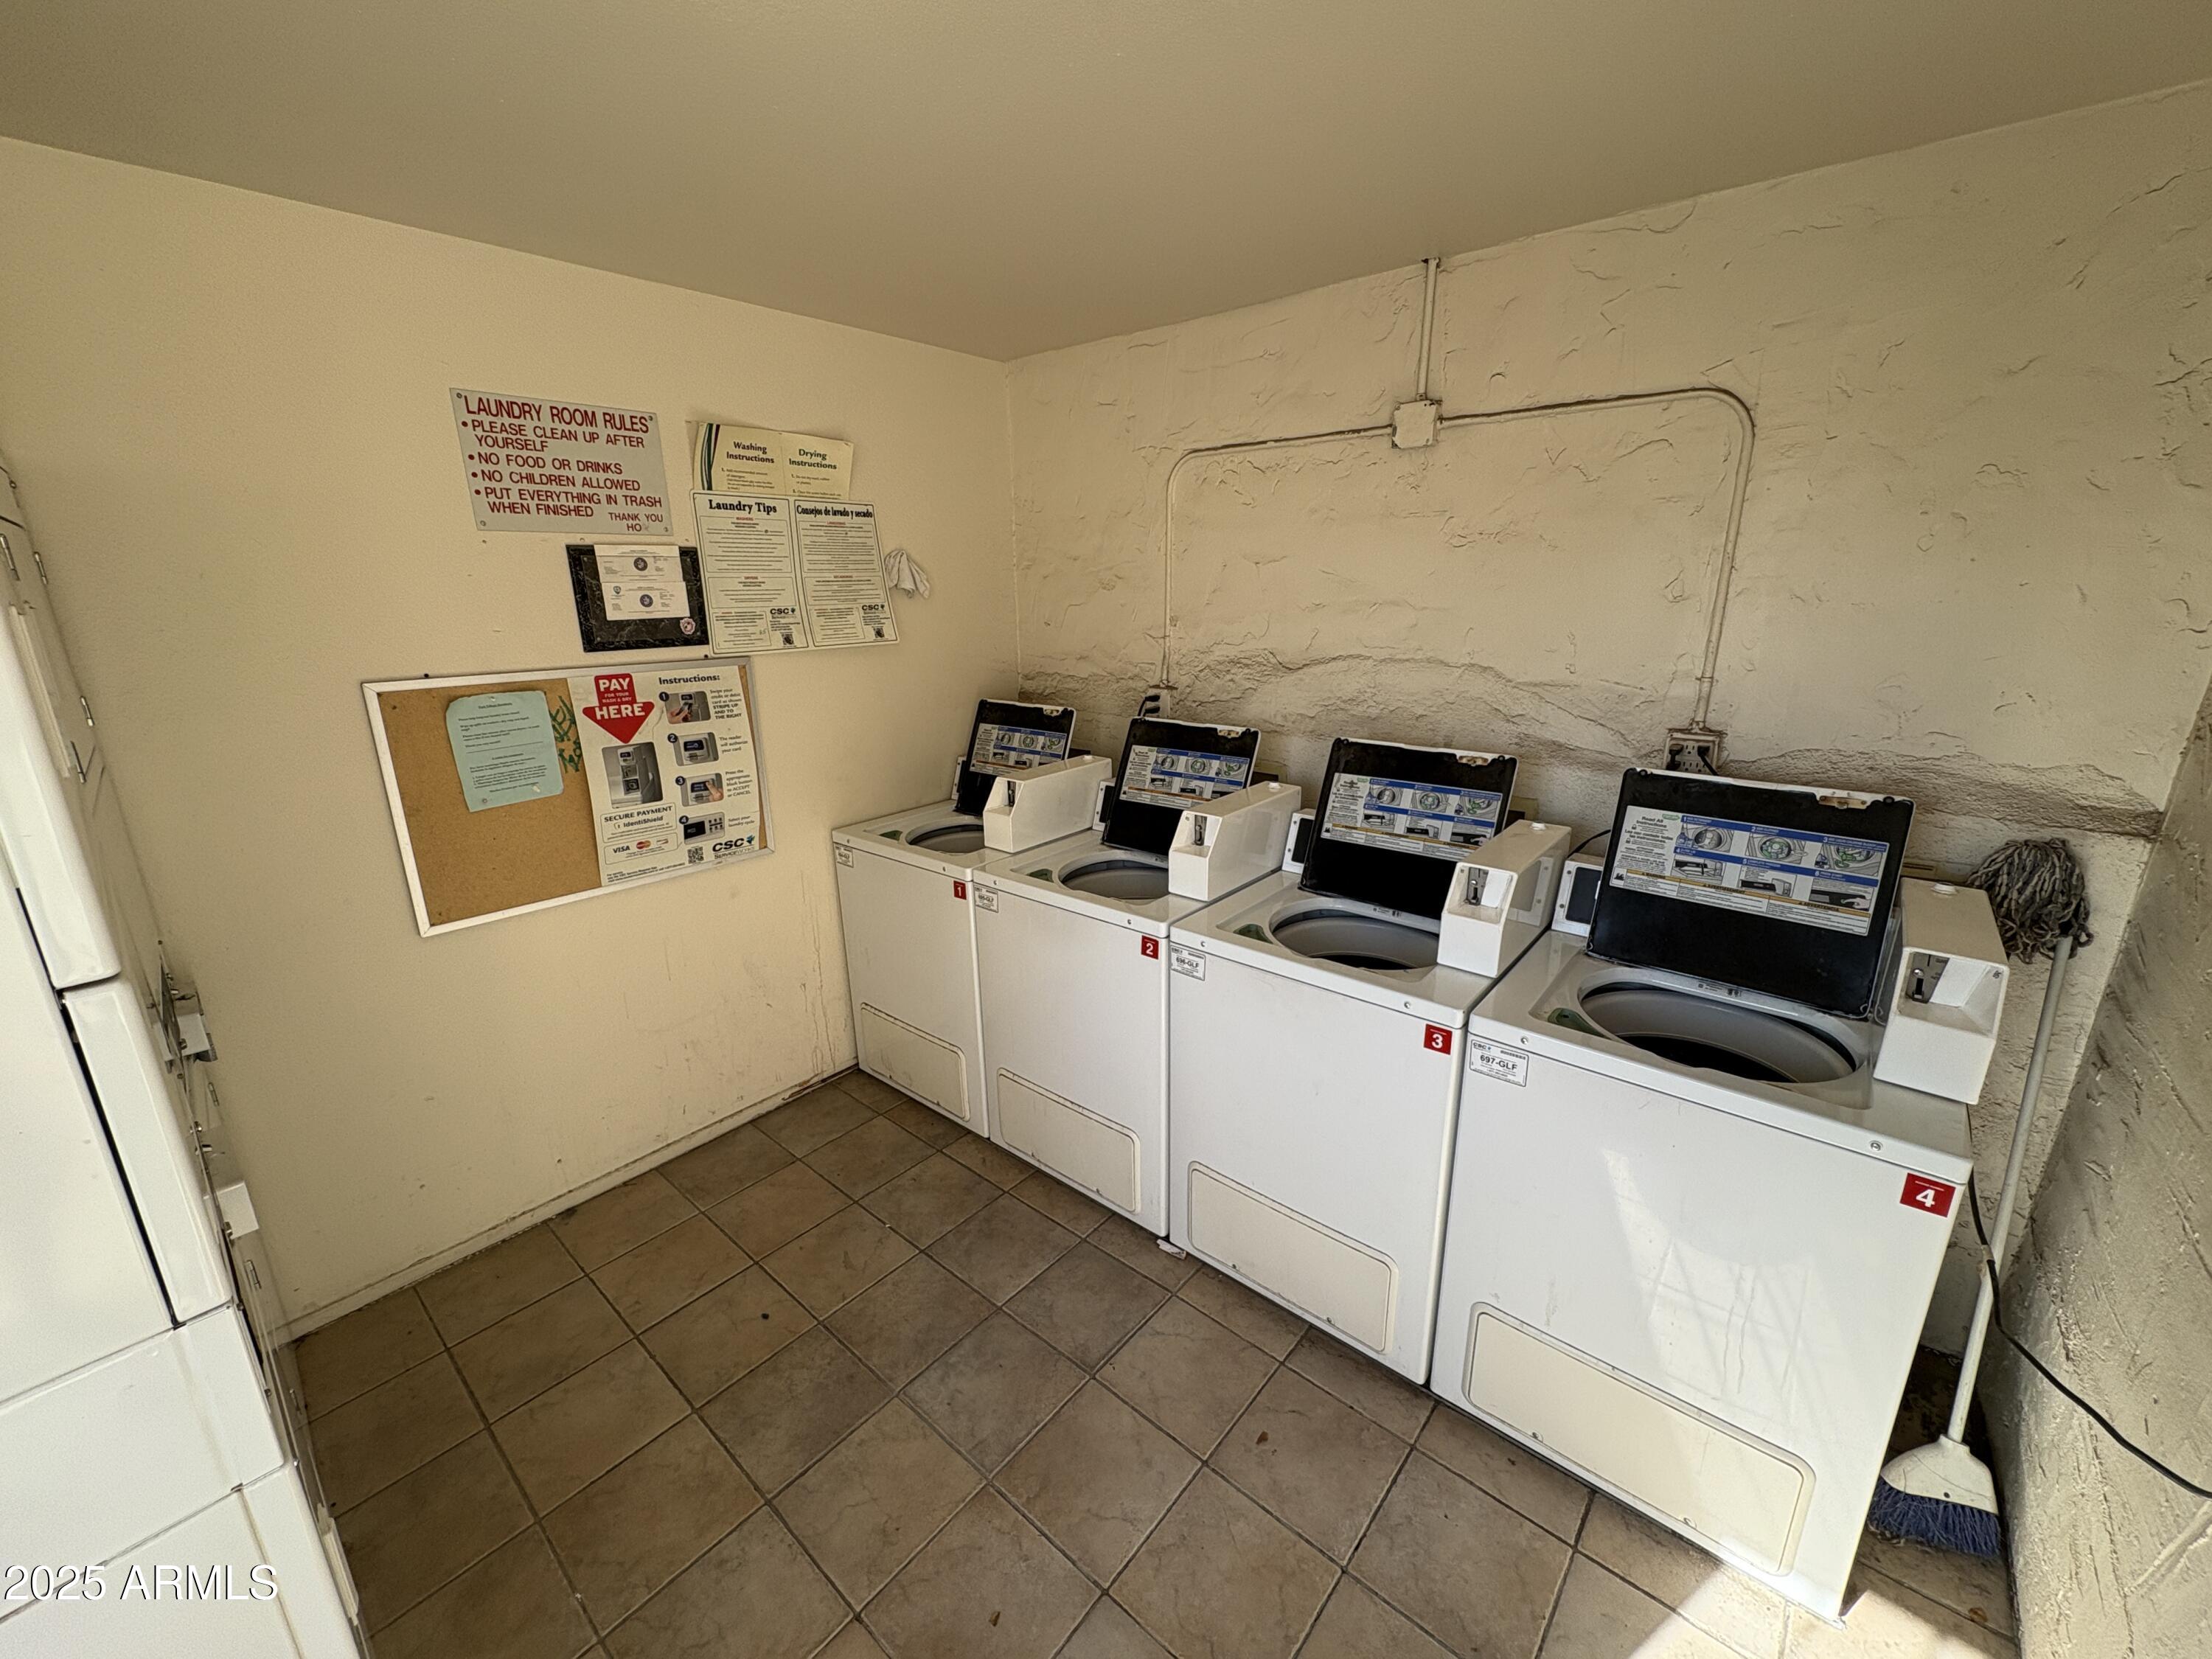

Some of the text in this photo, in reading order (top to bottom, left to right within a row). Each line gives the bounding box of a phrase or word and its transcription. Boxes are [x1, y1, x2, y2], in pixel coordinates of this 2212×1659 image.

[464, 395, 649, 433] LAUNDRY ROOM RULES
[472, 420, 644, 448] PLEASE CLEAN UP AFTER
[476, 435, 549, 452] YOURSELF
[733, 441, 767, 454] Washing
[727, 451, 774, 464] Instructions
[799, 448, 827, 460] Drying
[478, 452, 622, 475] NO FOOD OR DRINKS
[789, 459, 837, 470] Instructions
[481, 470, 641, 492] NO CHILDREN ALLOWED
[484, 487, 662, 508] PUT EVERYTHING IN TRASH
[487, 501, 594, 518] WHEN FINISHED
[709, 499, 777, 515] Laundry Tips
[796, 504, 873, 519] Consejos de lavado y secado
[608, 512, 663, 522] THANK YOU
[599, 678, 630, 692] PAY
[659, 674, 720, 685] Instructions:
[594, 703, 646, 720] HERE
[605, 806, 672, 823] SECURE PAYMENT
[624, 815, 664, 827] IdentiShield
[612, 845, 630, 854] VISA
[712, 838, 745, 852] CSC
[957, 886, 961, 897] 1
[1146, 942, 1153, 956] 2
[1431, 1034, 1443, 1048] 3
[1481, 1054, 1517, 1071] 697-GLF
[1916, 1189, 1935, 1208] 4
